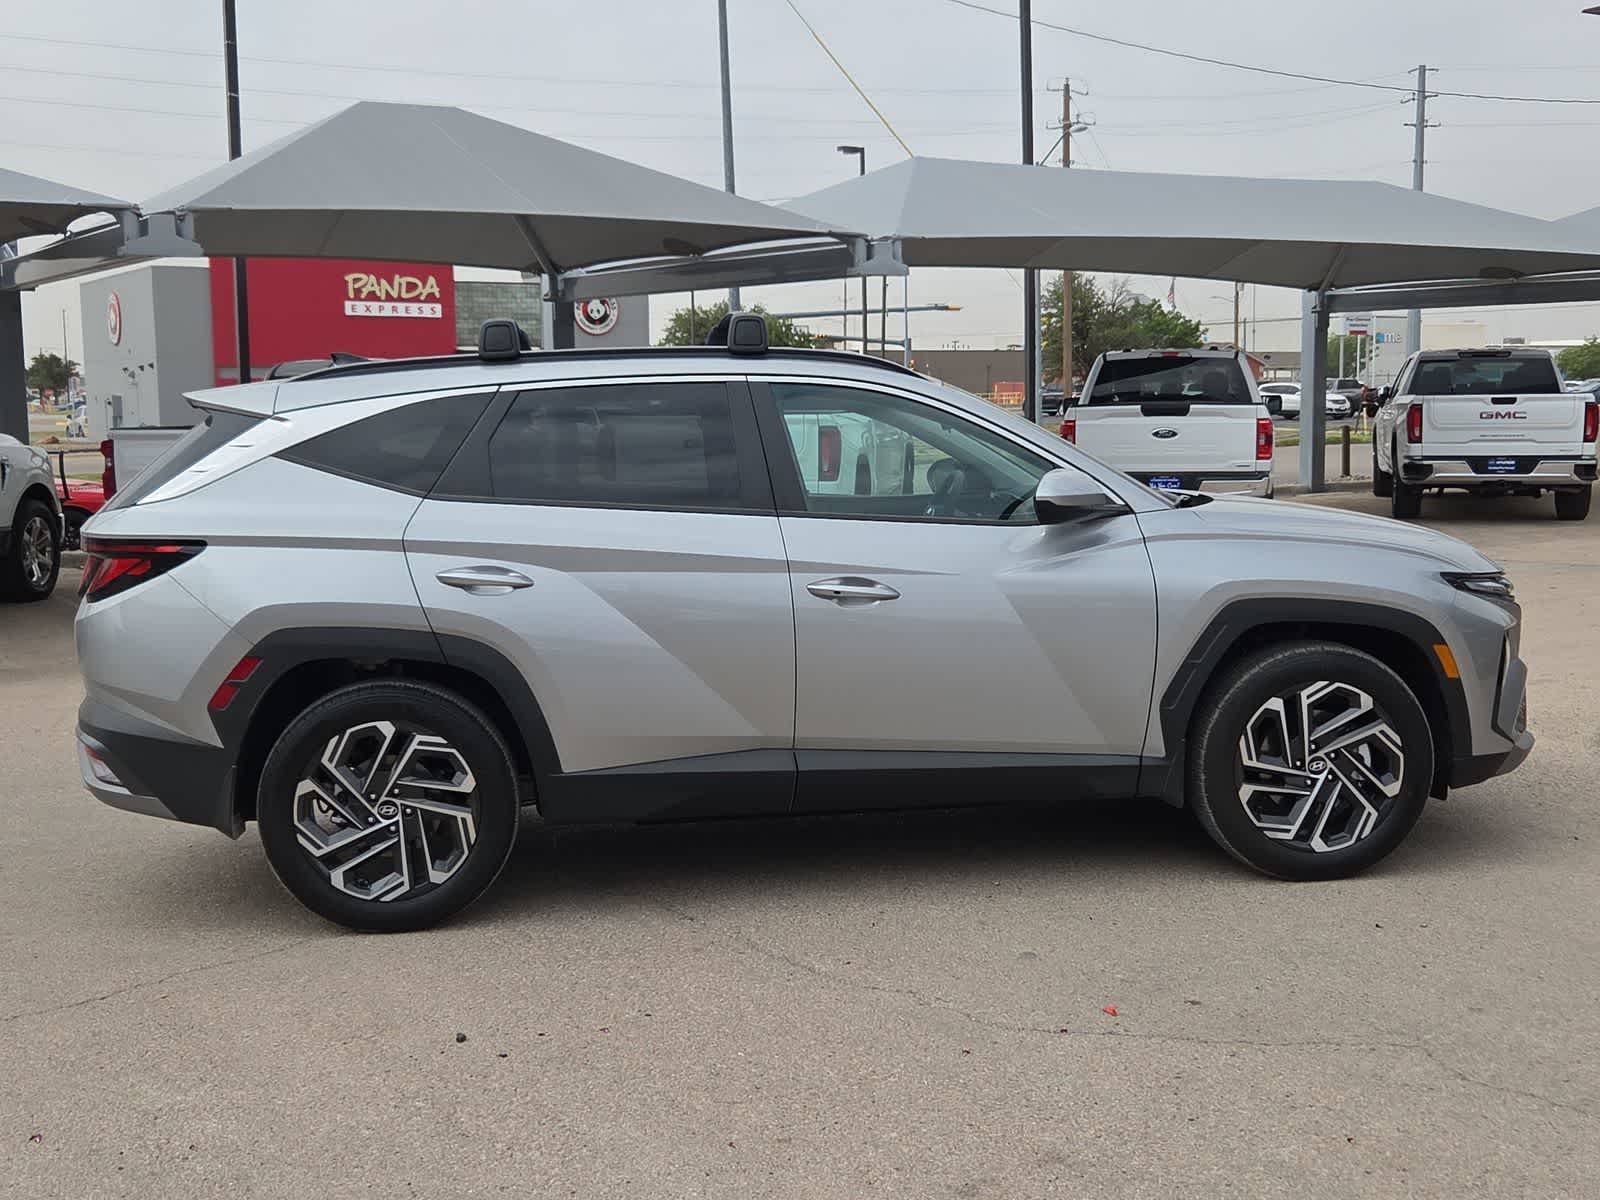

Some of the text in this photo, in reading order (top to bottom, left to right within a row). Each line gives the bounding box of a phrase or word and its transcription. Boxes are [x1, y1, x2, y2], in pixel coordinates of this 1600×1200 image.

[344, 273, 440, 300] PANDA
[351, 304, 437, 315] EXPRESS
[1479, 411, 1528, 420] GMC
